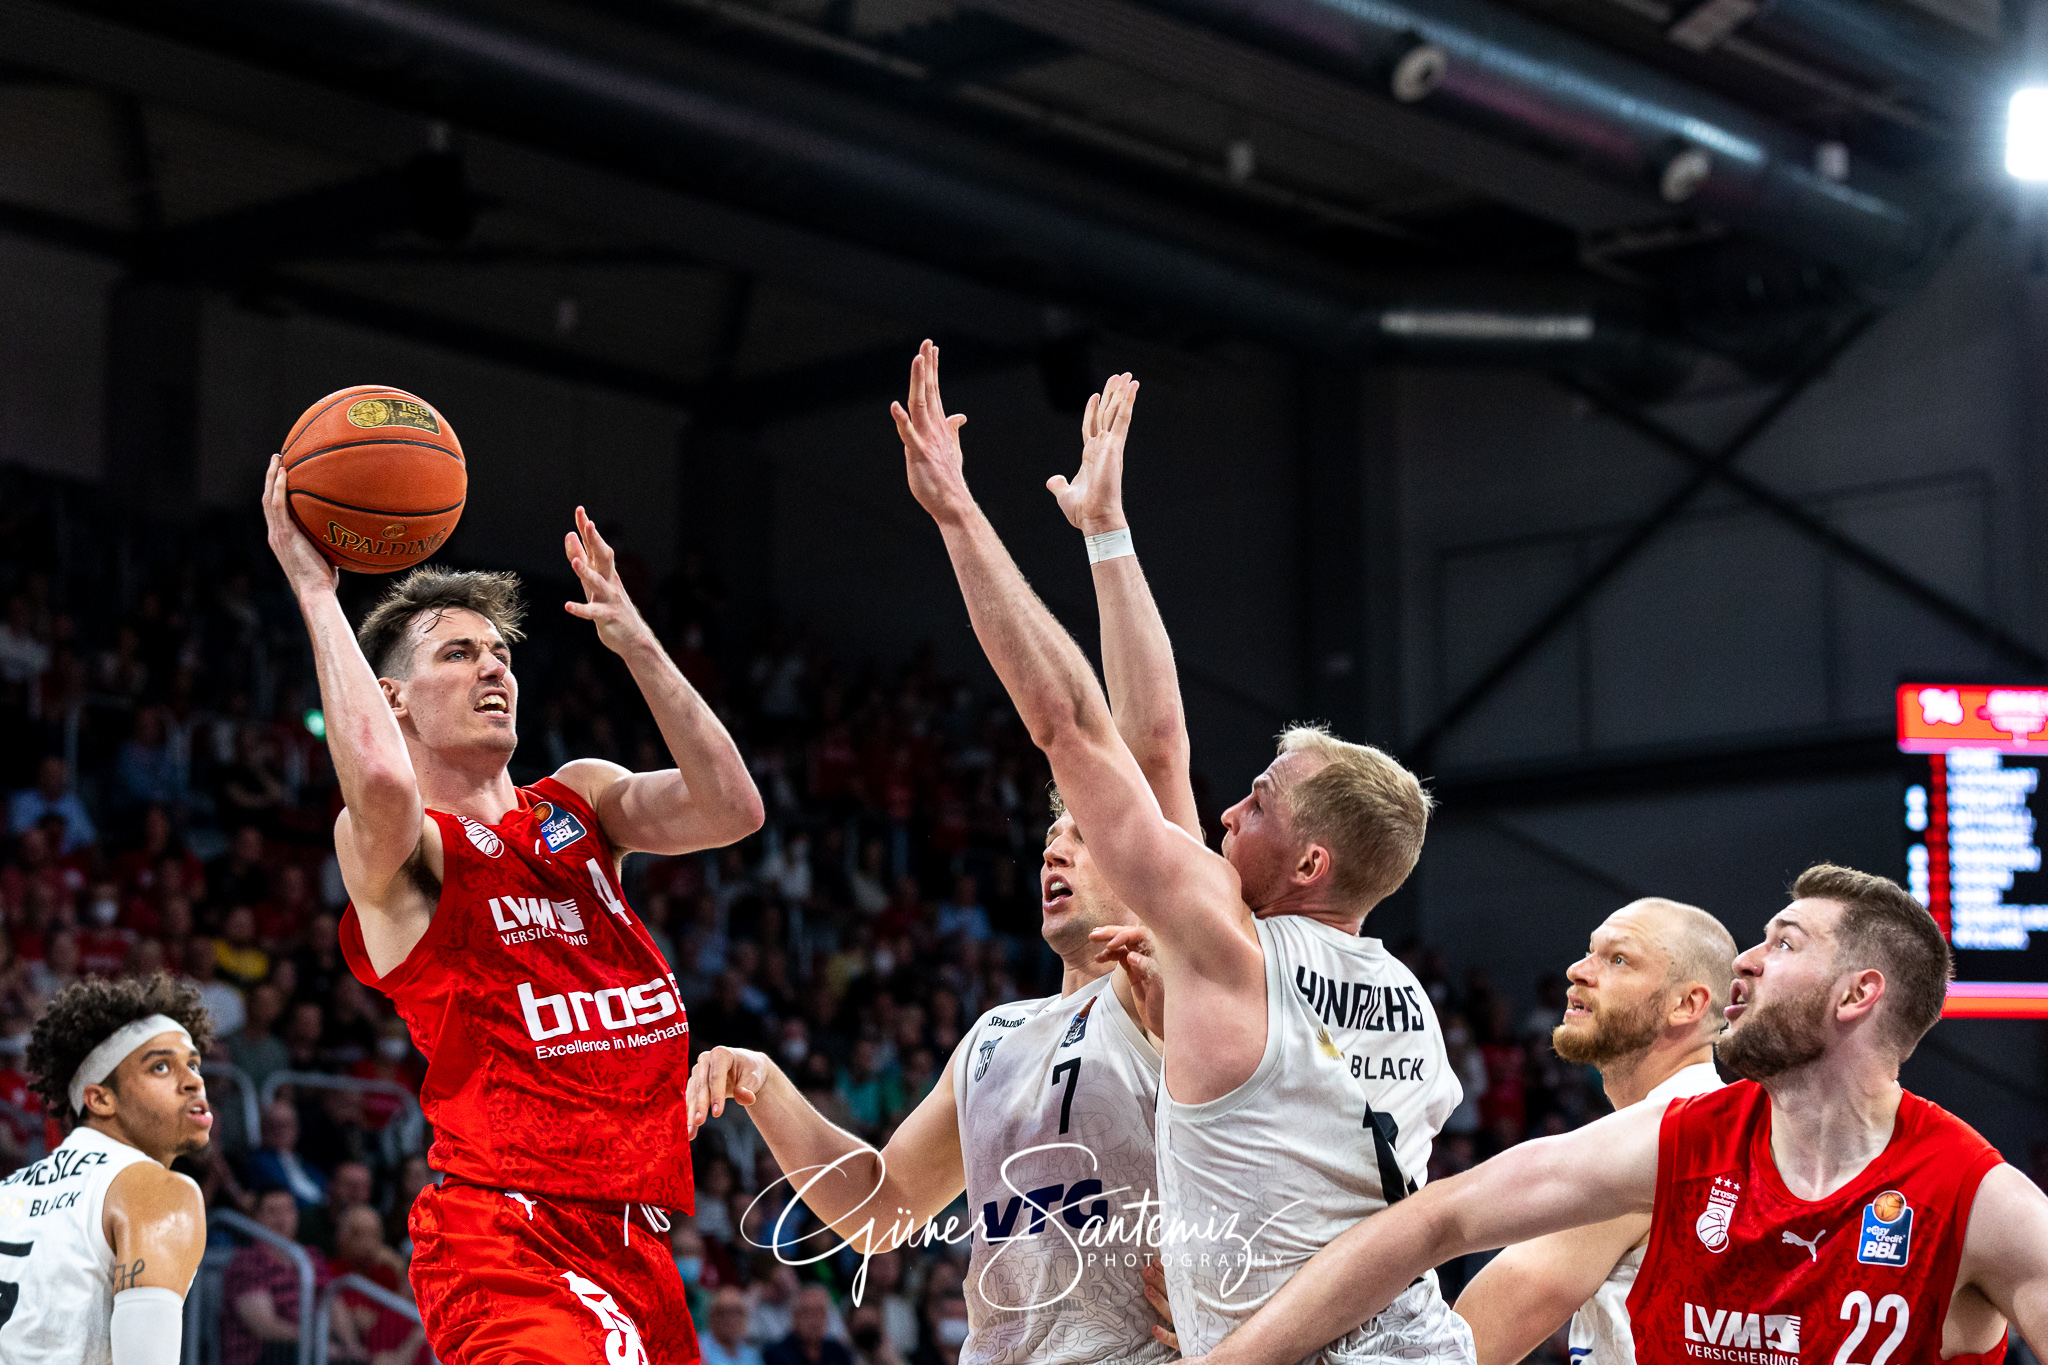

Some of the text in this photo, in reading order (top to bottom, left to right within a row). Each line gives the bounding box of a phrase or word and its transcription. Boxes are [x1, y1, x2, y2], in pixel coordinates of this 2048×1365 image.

[323, 521, 448, 556] SPALDING
[546, 825, 579, 848] BBL
[585, 857, 632, 926] 4
[488, 895, 557, 932] LVM
[501, 926, 588, 946] VERSICNG
[1296, 965, 1425, 1032] HINRICHS
[536, 1039, 610, 1059] Excellence
[612, 1036, 626, 1050] in
[1350, 1054, 1424, 1081] BLACK
[1052, 1057, 1081, 1135] 7
[1710, 1185, 1739, 1202] brose
[984, 1179, 1109, 1246] VTG
[1862, 1240, 1901, 1260] BBL
[1875, 1234, 1904, 1244] Credit
[1684, 1302, 1762, 1350] LVM
[1832, 1290, 1910, 1365] 22
[1685, 1342, 1800, 1365] VERSICHERUNG
